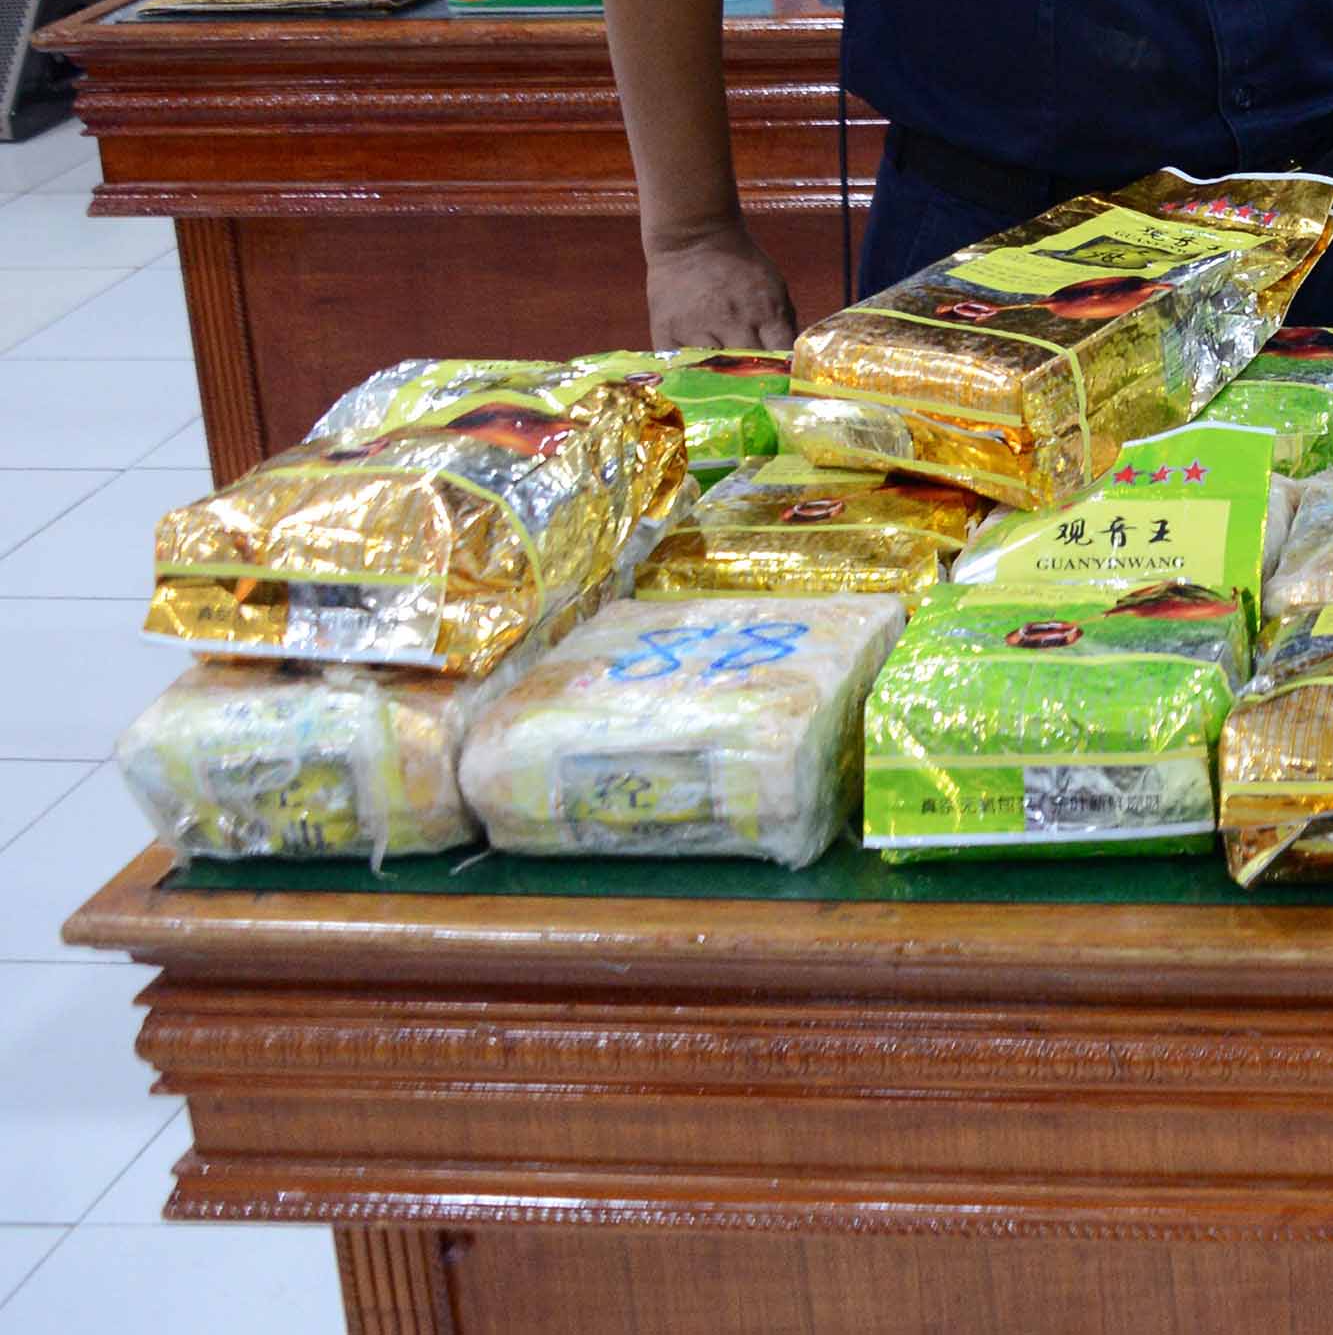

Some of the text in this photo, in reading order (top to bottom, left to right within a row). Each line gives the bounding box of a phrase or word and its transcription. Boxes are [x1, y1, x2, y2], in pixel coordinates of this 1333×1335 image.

[1055, 516, 1173, 548] 观音王
[1036, 555, 1186, 572] GUANYINWANG
[607, 621, 810, 683] 88
